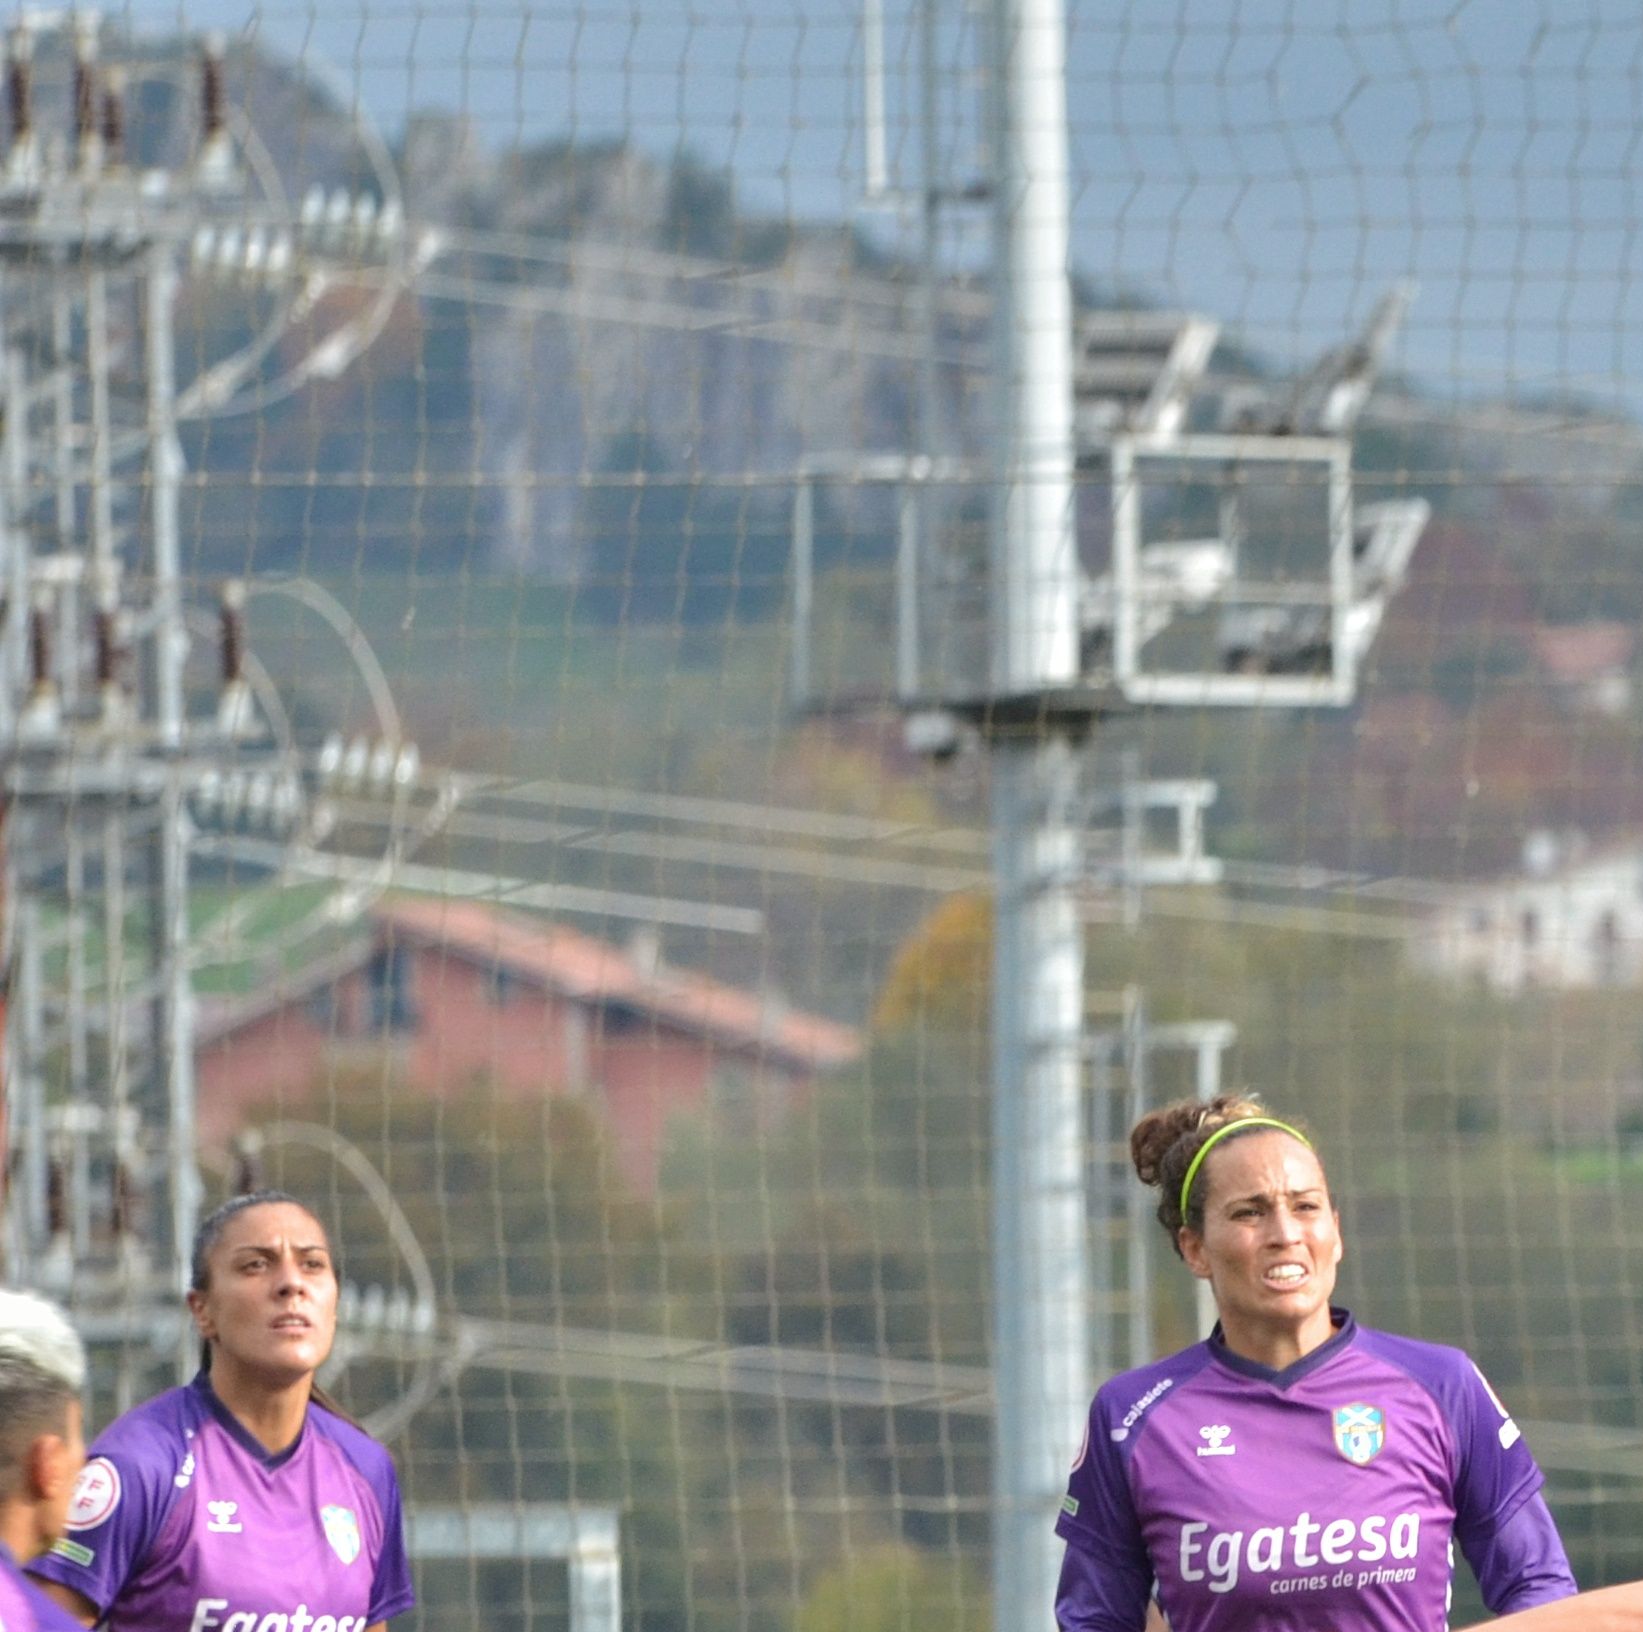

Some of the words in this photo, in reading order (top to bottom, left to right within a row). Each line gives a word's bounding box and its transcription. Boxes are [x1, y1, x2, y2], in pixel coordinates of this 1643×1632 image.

[1179, 1512, 1421, 1593] Egatesa
[1270, 1574, 1328, 1594] carnes
[1332, 1569, 1354, 1588] de
[1357, 1565, 1416, 1590] primera
